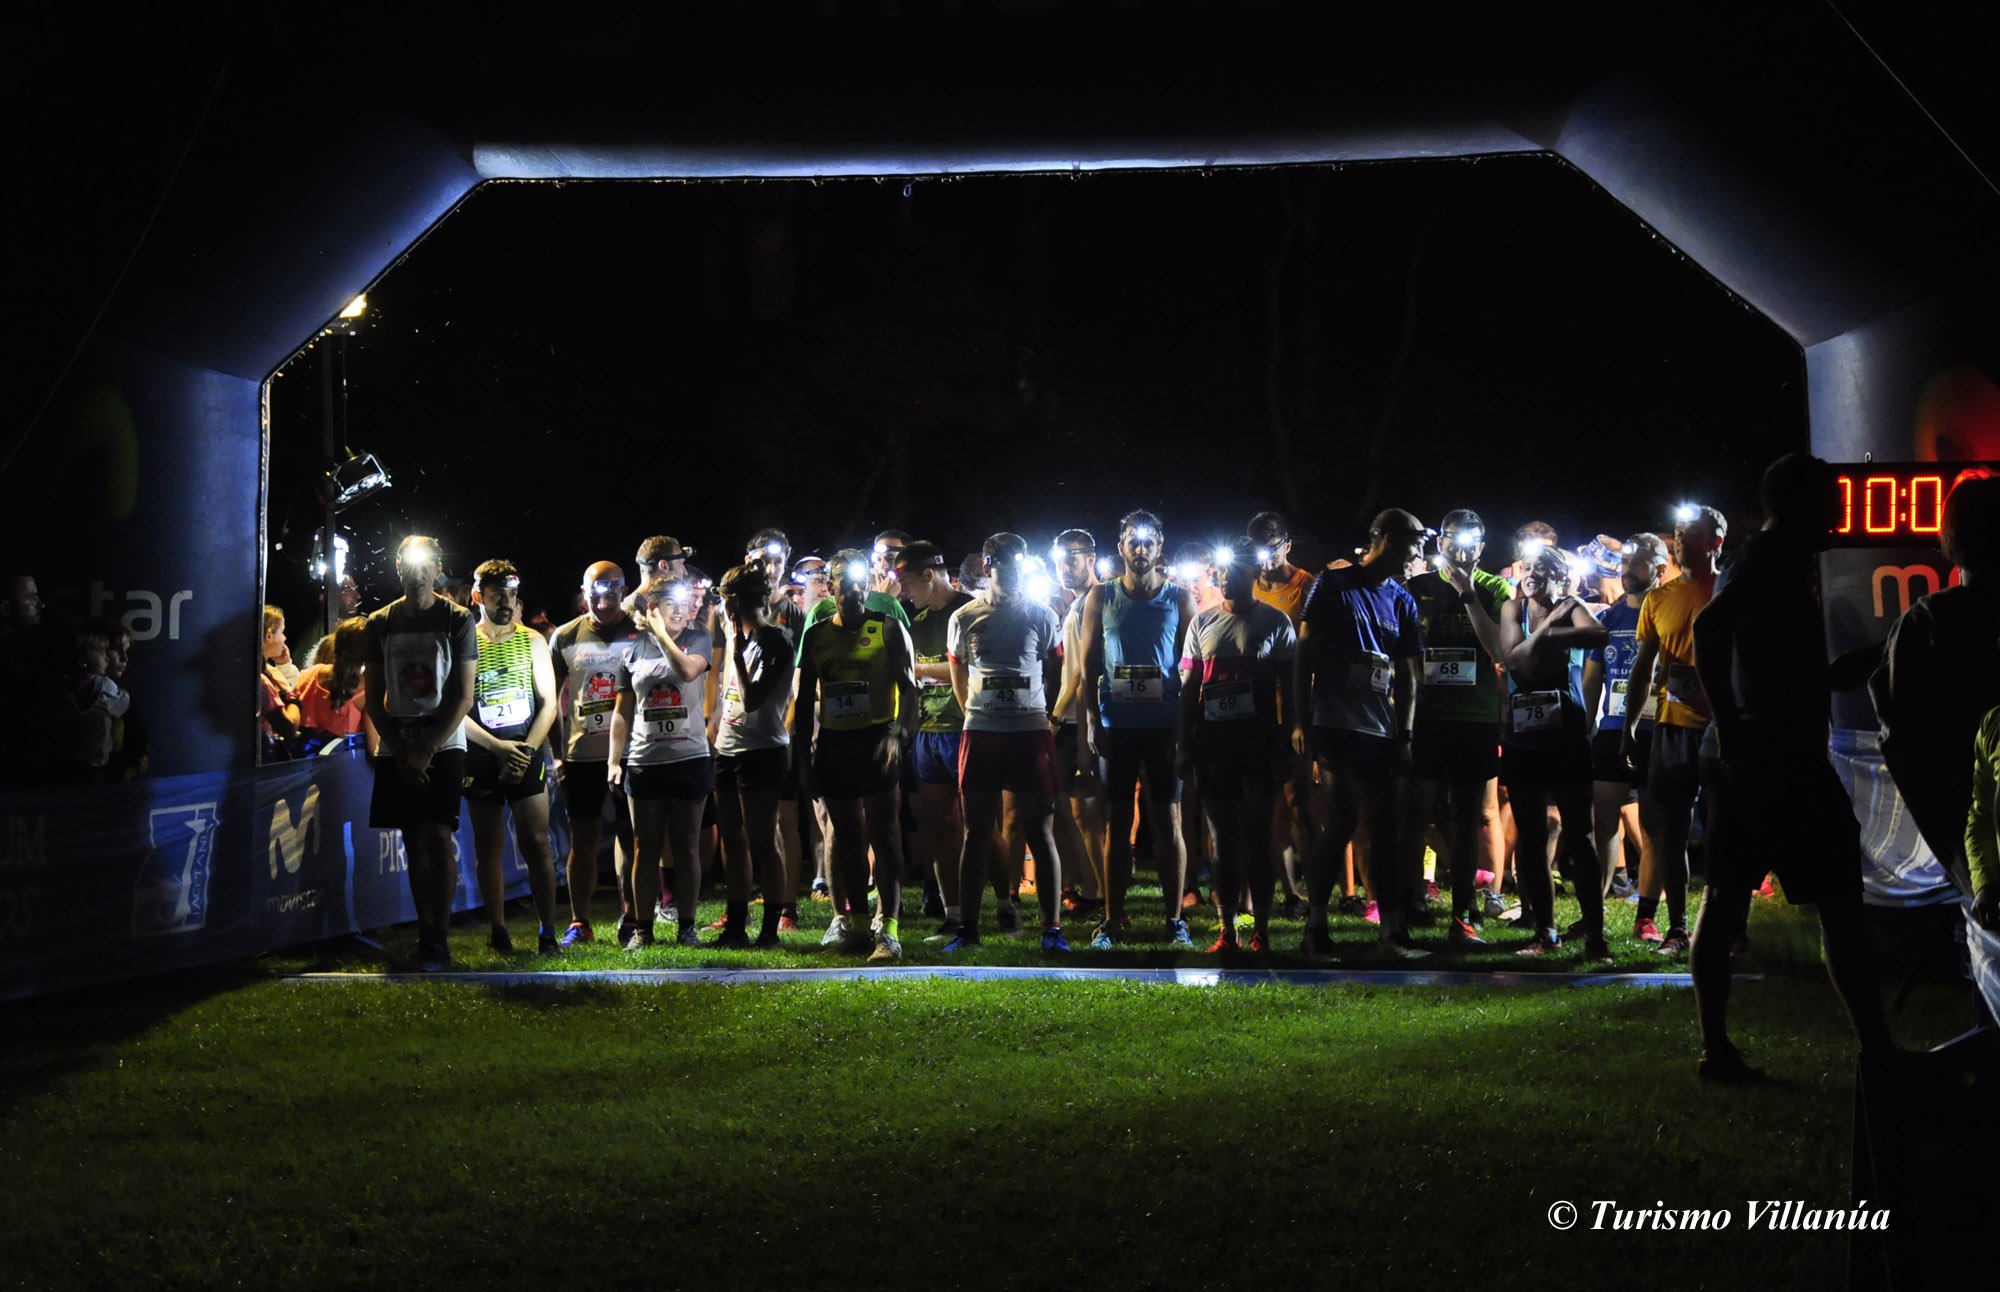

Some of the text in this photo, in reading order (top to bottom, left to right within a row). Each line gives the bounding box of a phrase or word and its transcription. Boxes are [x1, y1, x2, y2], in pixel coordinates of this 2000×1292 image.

[1440, 662, 1459, 675] 68
[1128, 680, 1145, 692] 16
[836, 696, 853, 709] 14
[997, 690, 1015, 702] 42
[496, 704, 512, 716] 21
[1219, 697, 1237, 710] 69
[1525, 706, 1544, 720] 78
[594, 714, 604, 726] 9
[657, 720, 675, 733] 10
